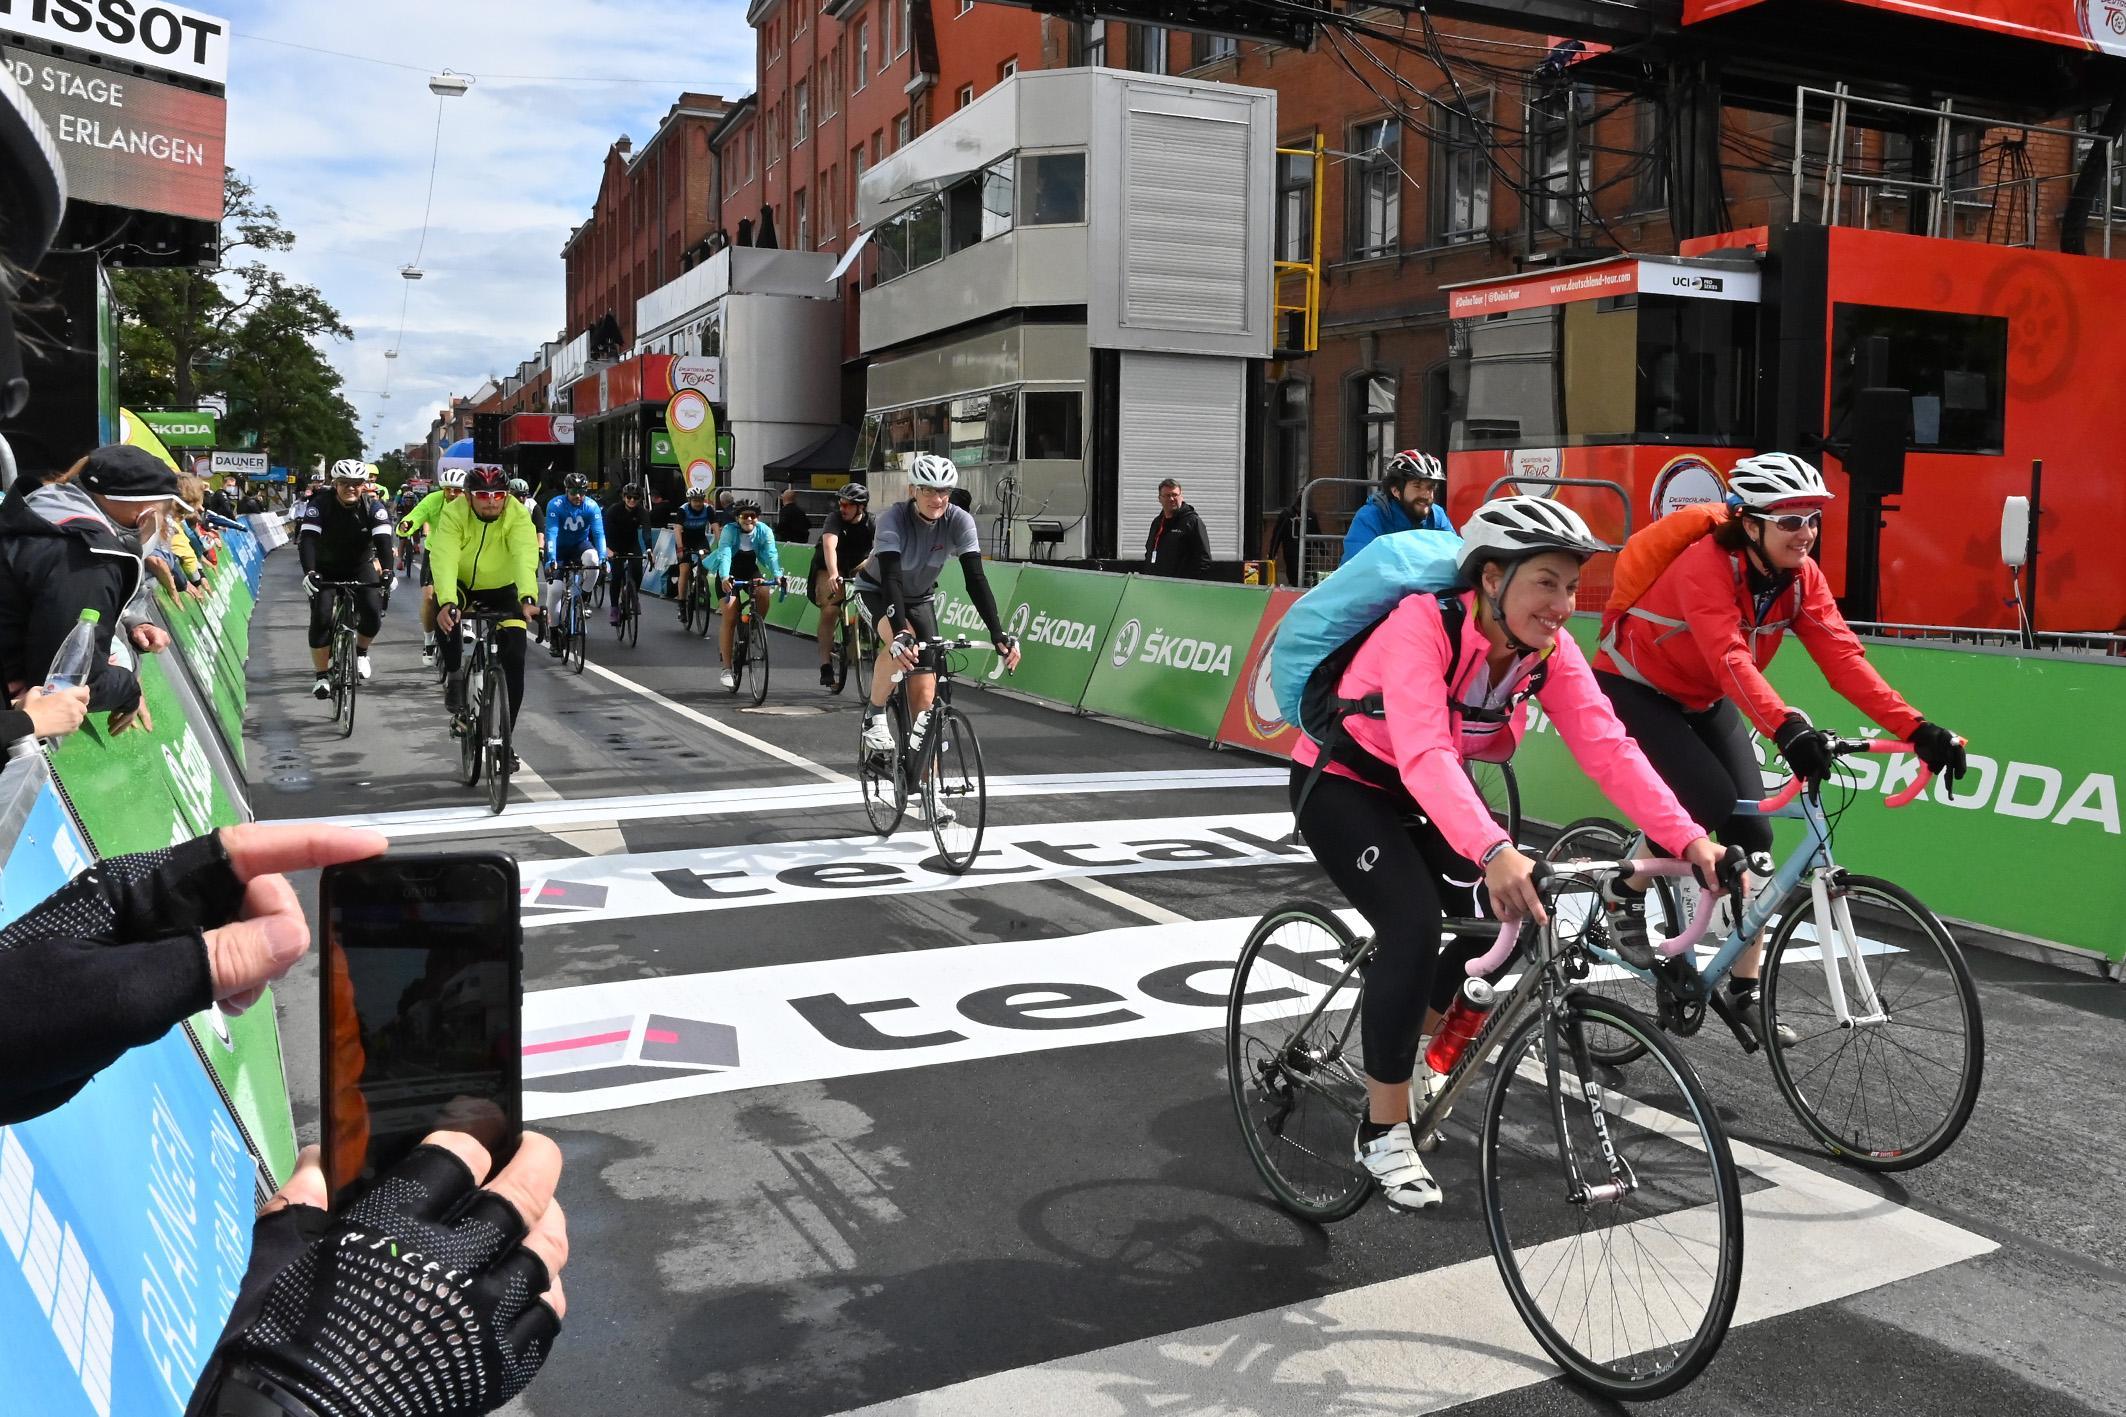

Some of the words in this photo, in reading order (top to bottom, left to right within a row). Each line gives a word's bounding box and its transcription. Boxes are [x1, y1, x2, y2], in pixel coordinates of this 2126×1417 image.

[0, 0, 221, 65] ISSOT
[42, 67, 123, 108] STAGE
[59, 114, 203, 166] ERLANGEN
[1550, 273, 1631, 294] www.deutschland-tour.com
[1672, 276, 1690, 287] UCI
[681, 372, 715, 386] TOUR
[149, 422, 212, 435] ŠKODA
[215, 456, 265, 468] DAUNER
[1522, 464, 1550, 478] TOUR
[1027, 611, 1096, 652] ŠKODA
[1140, 627, 1233, 677] ŠKODA
[1828, 727, 2121, 834] ŠKODA
[651, 826, 1308, 900] tectak
[1585, 1081, 1620, 1174] EASTON
[141, 1081, 198, 1416] ERLANGEN
